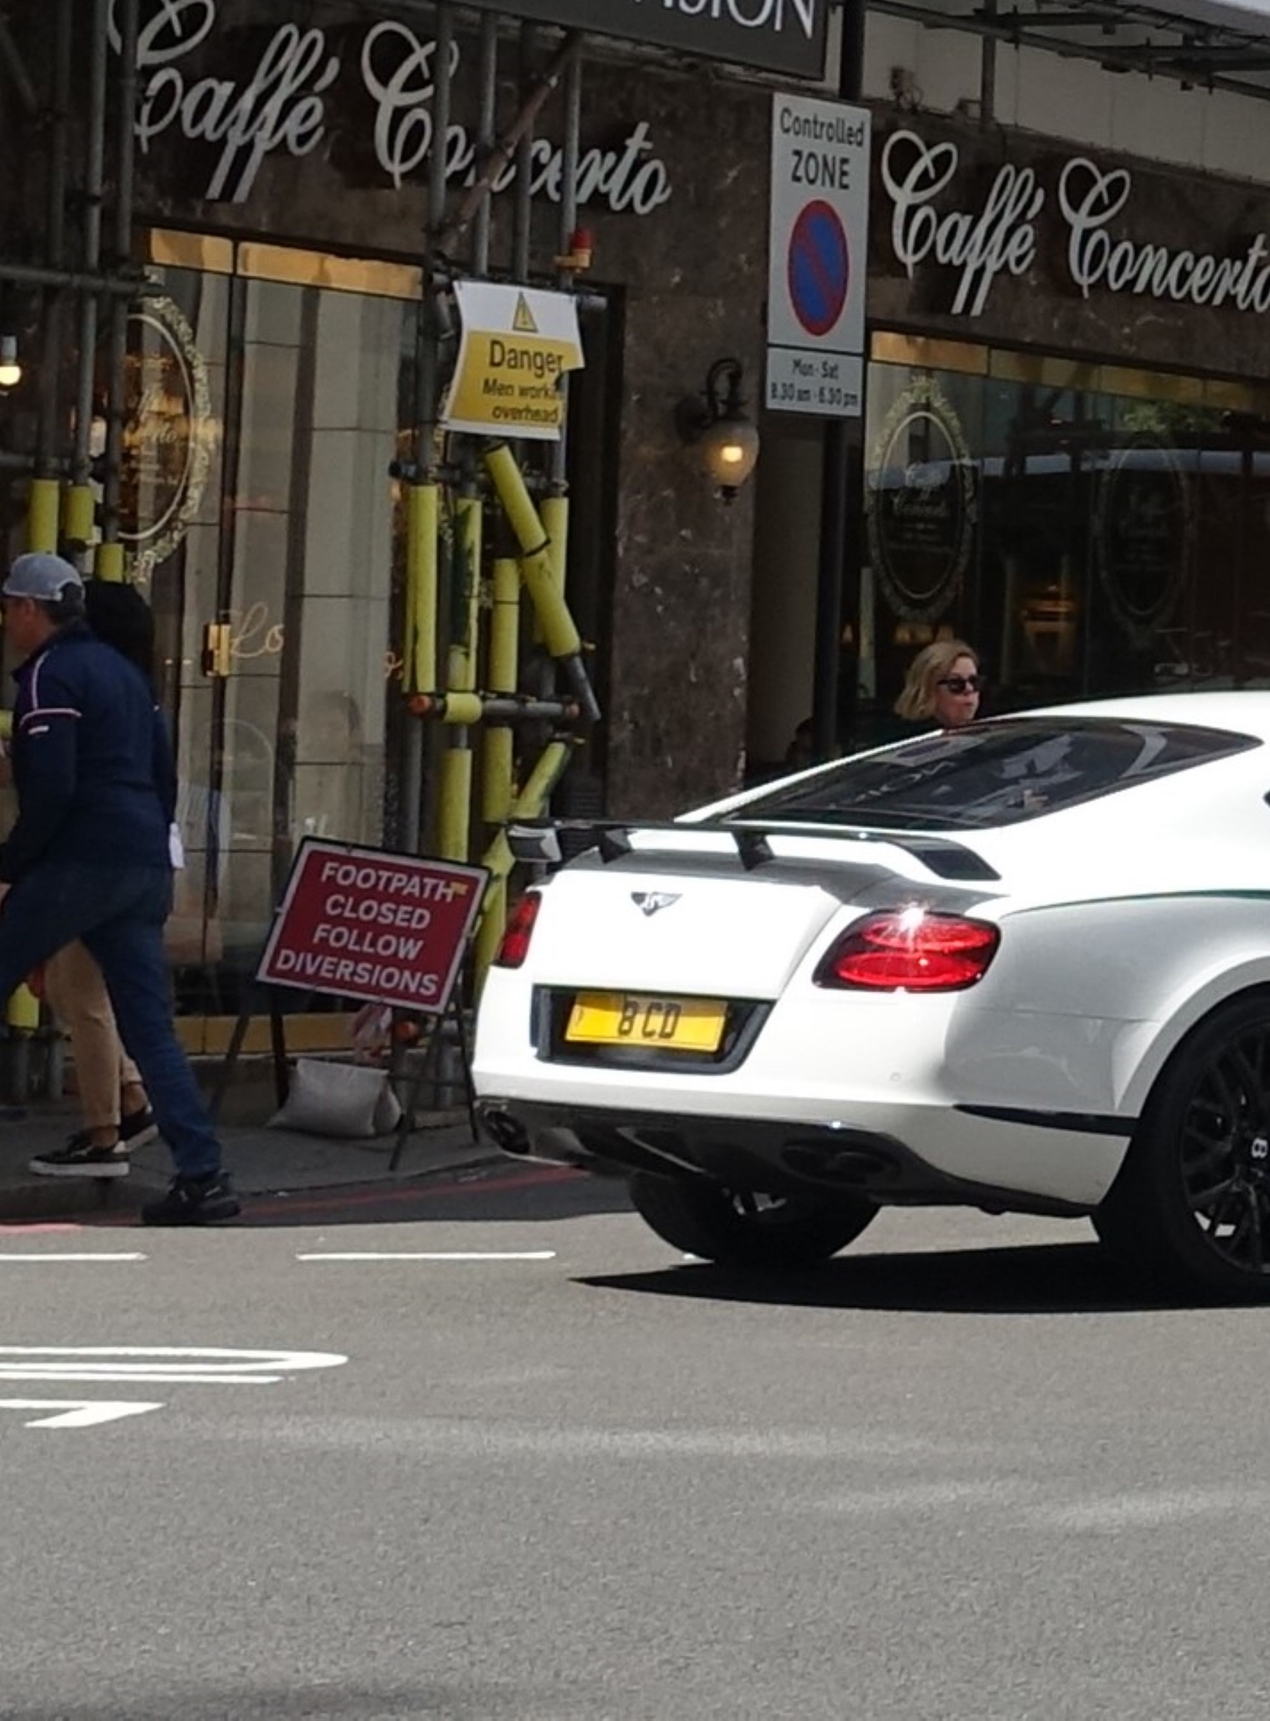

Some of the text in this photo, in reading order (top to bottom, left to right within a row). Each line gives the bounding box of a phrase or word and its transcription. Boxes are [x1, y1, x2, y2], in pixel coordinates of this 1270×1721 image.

[780, 107, 865, 148] Controlled
[791, 149, 851, 190] ZONE
[881, 129, 1045, 317] Caffé
[489, 339, 564, 379] Danger
[482, 378, 515, 397] Men
[491, 404, 559, 424] overhead
[321, 861, 455, 903] FOOTPATH
[325, 894, 431, 930] CLOSED
[312, 923, 425, 961] FOLLOW
[275, 948, 440, 997] DIVERSIONS
[641, 1001, 682, 1039] CD
